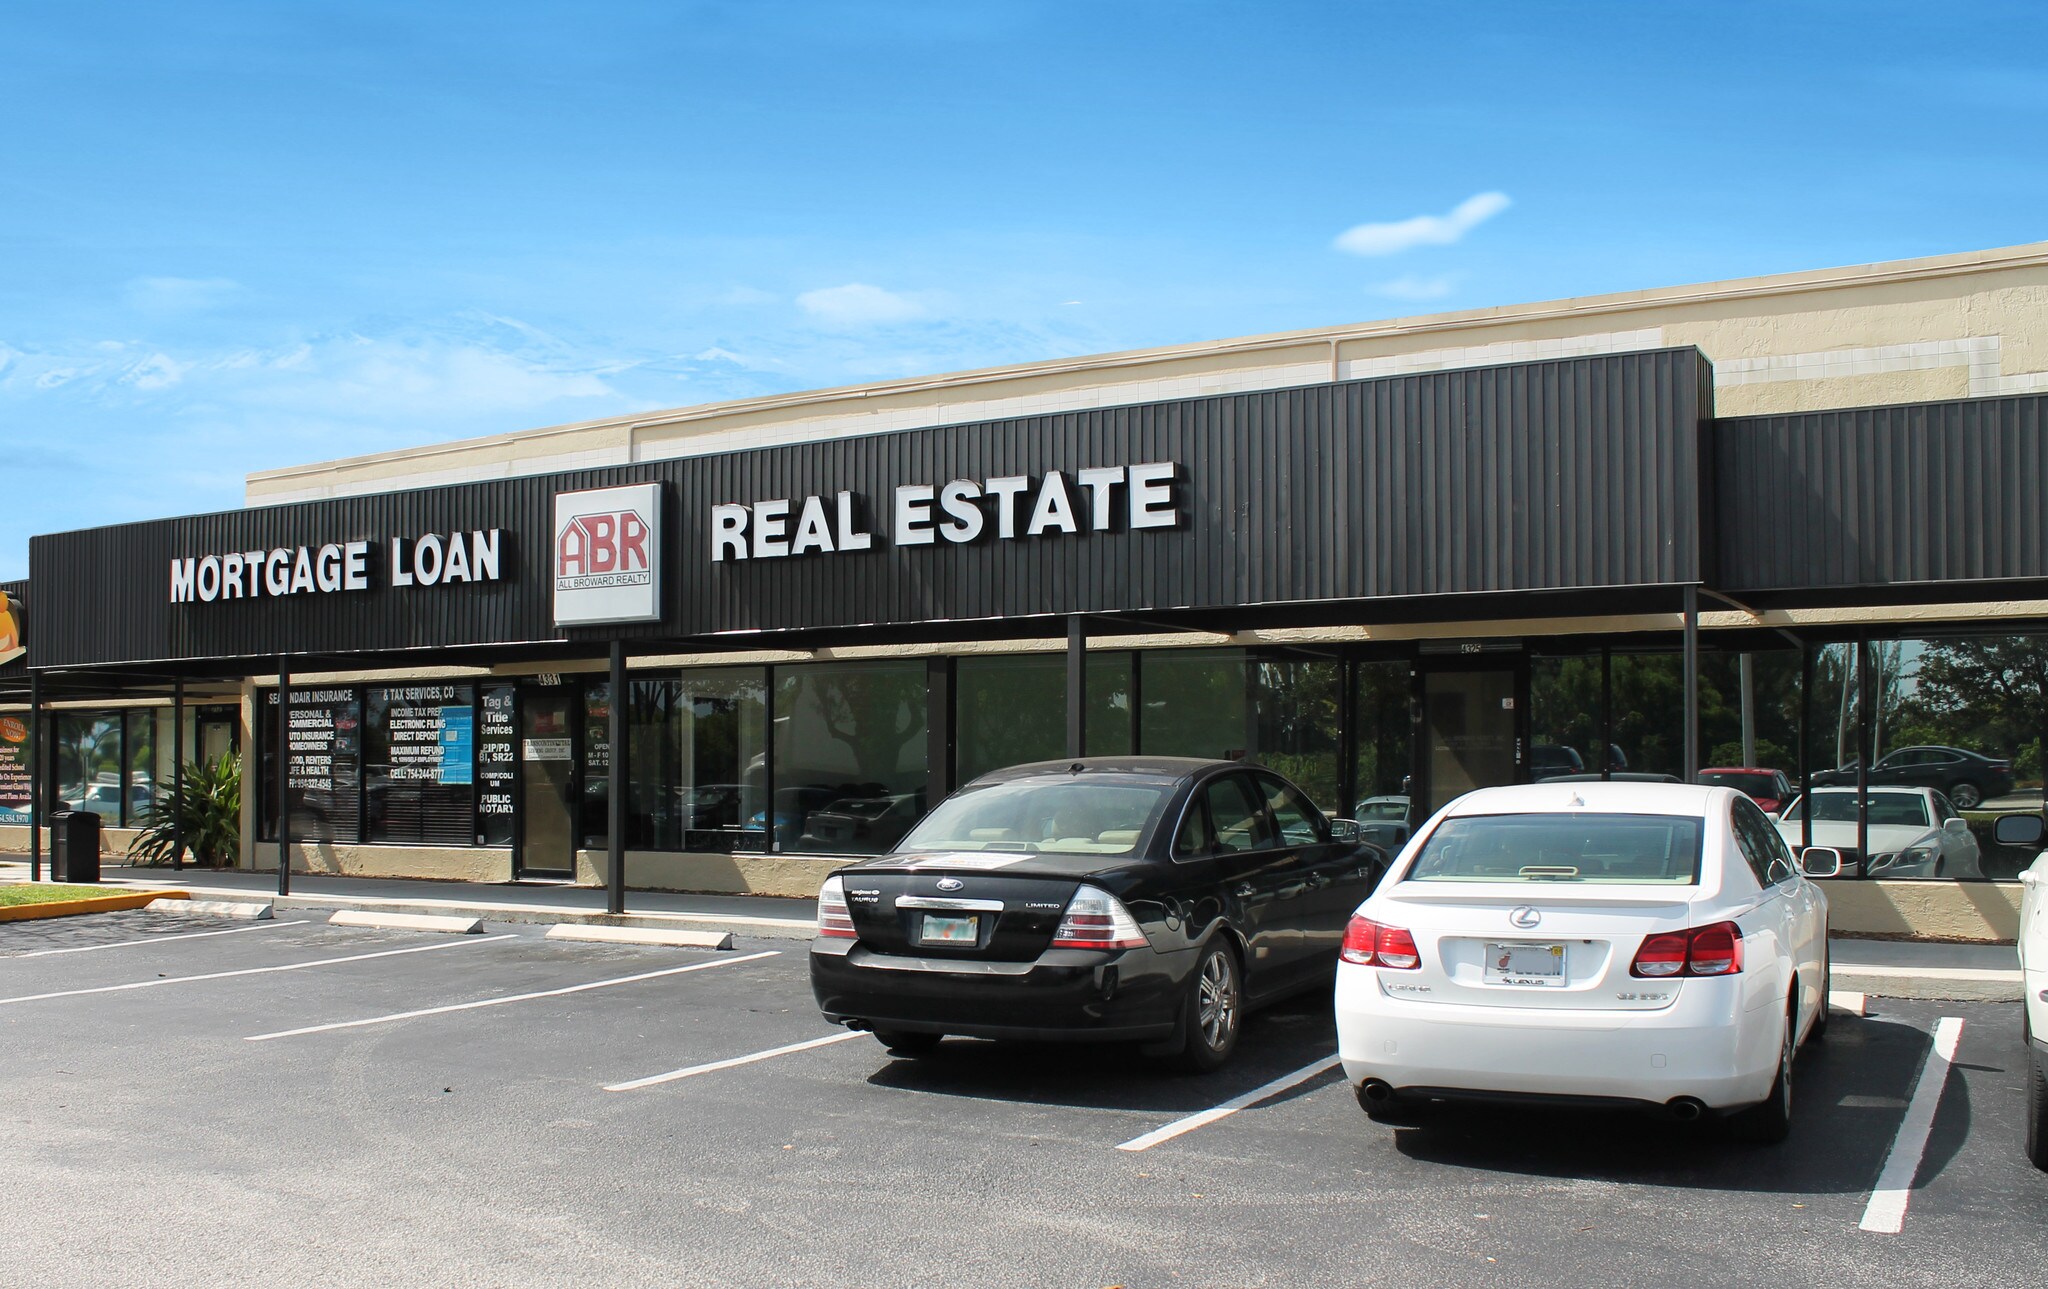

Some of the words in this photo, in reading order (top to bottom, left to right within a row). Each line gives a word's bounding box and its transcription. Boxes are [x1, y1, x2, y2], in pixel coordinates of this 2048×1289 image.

[712, 490, 871, 561] REAL
[895, 462, 1177, 545] ESTATE
[559, 512, 648, 576] ABR
[170, 541, 368, 603] MORTGAGE
[392, 528, 500, 587] LOAN
[558, 577, 573, 589] ALL
[574, 575, 615, 588] BROWARD
[616, 573, 648, 585] REALTY
[312, 689, 353, 702] INSURANCE
[383, 688, 389, 701] &
[390, 688, 404, 700] TAX
[405, 686, 442, 701] SERVICES,
[443, 686, 455, 699] CO
[481, 696, 502, 709] Tag
[503, 695, 512, 706] &
[325, 709, 331, 719] &
[391, 708, 414, 717] INCOME
[415, 708, 427, 716] TAX
[486, 711, 509, 723] Title
[3, 719, 24, 731] ENROLL
[390, 719, 426, 729] ELECTRONIC
[426, 719, 446, 728] FILING
[481, 724, 513, 735] Services
[289, 731, 301, 740] UTO
[301, 731, 334, 740] INSURANCE
[393, 731, 415, 740] DIRECT
[415, 731, 441, 740] DEPOSIT
[390, 746, 420, 755] MAXIMUM
[420, 745, 445, 755] REFUND
[305, 755, 332, 765] RENTERS
[492, 752, 514, 762] SR22
[11, 763, 25, 771] School
[300, 766, 306, 775] &
[306, 765, 329, 775] HEALTH
[390, 768, 407, 779] CELL:
[480, 794, 511, 803] PUBLIC
[479, 804, 514, 814] NOTARY
